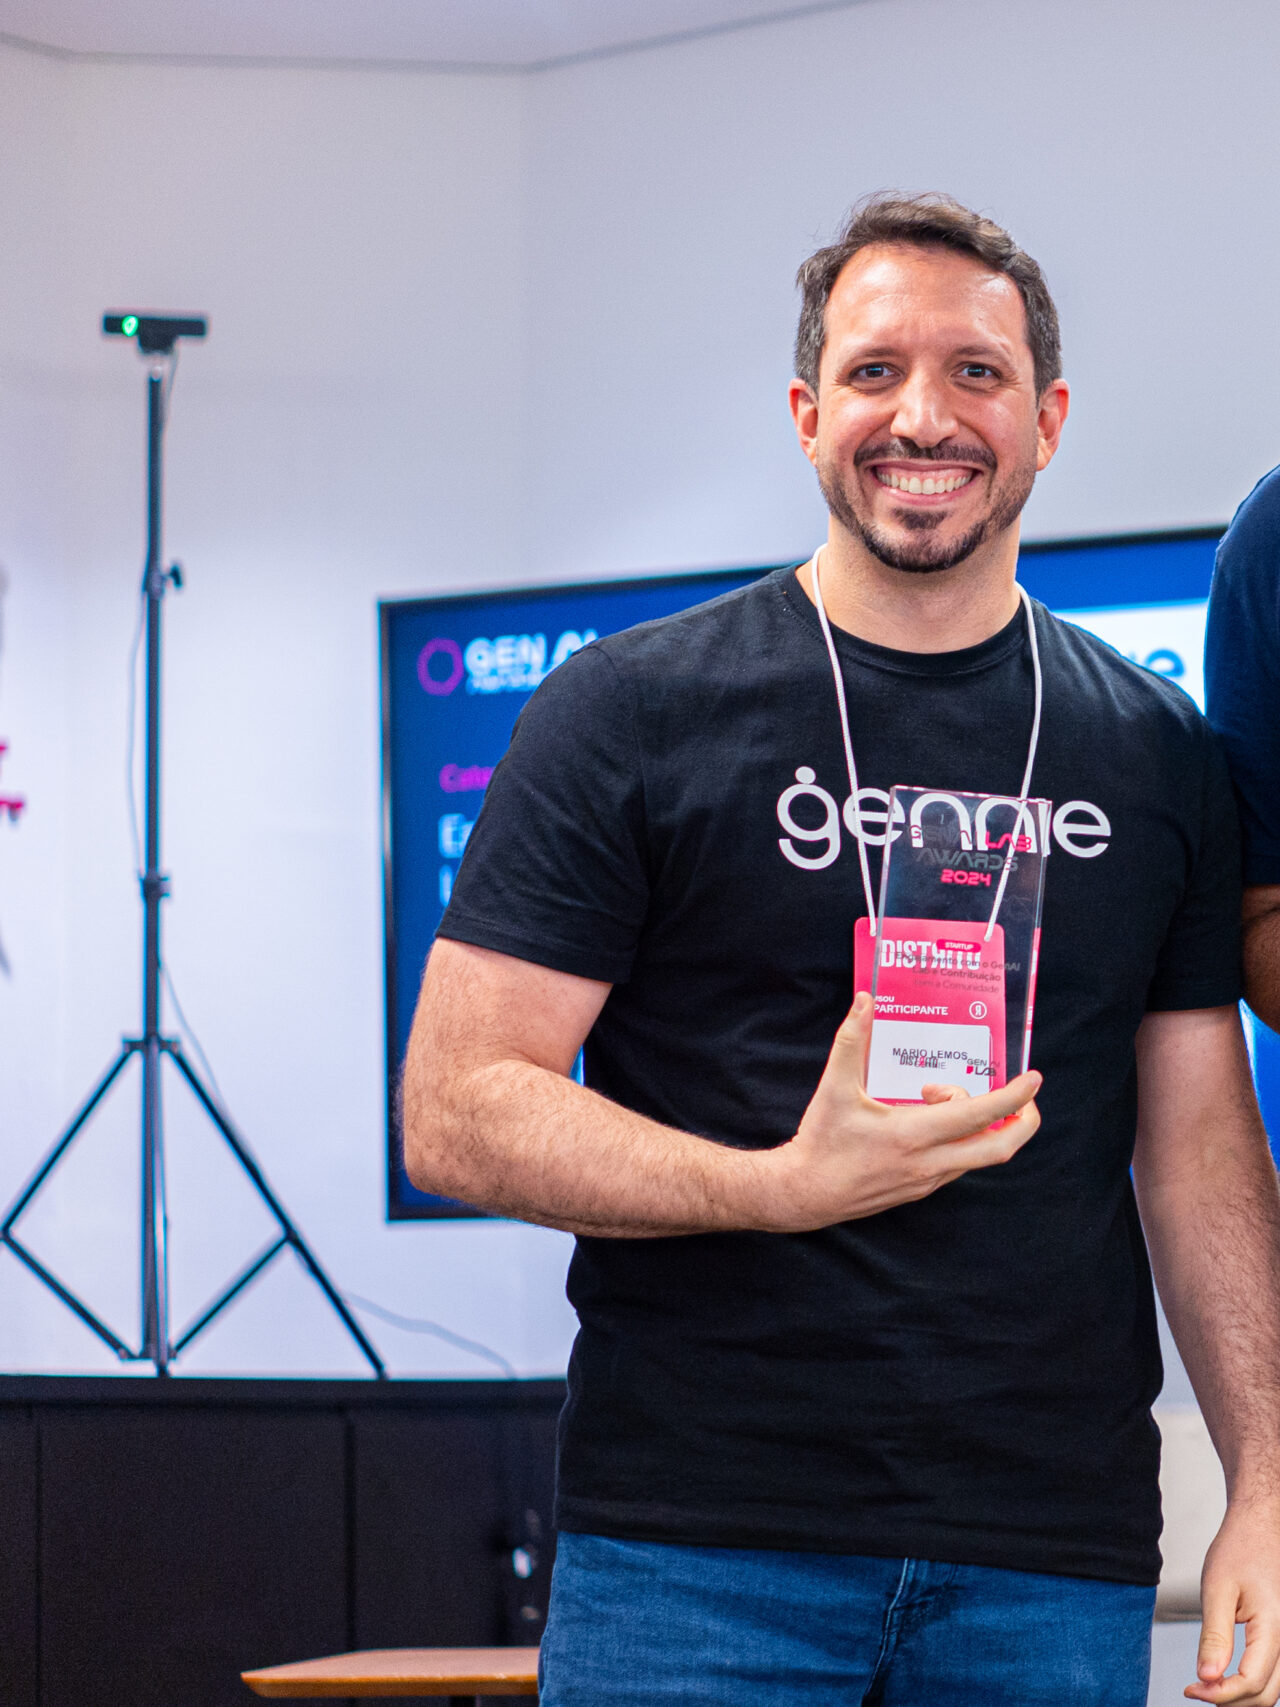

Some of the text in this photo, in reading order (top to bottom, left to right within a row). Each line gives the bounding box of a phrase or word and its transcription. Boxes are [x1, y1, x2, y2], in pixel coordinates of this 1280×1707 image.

[915, 847, 1019, 872] AWARDS
[941, 868, 992, 887] 2024
[944, 941, 974, 951] STARTUP
[892, 1048, 968, 1060] MARIO LEMOS
